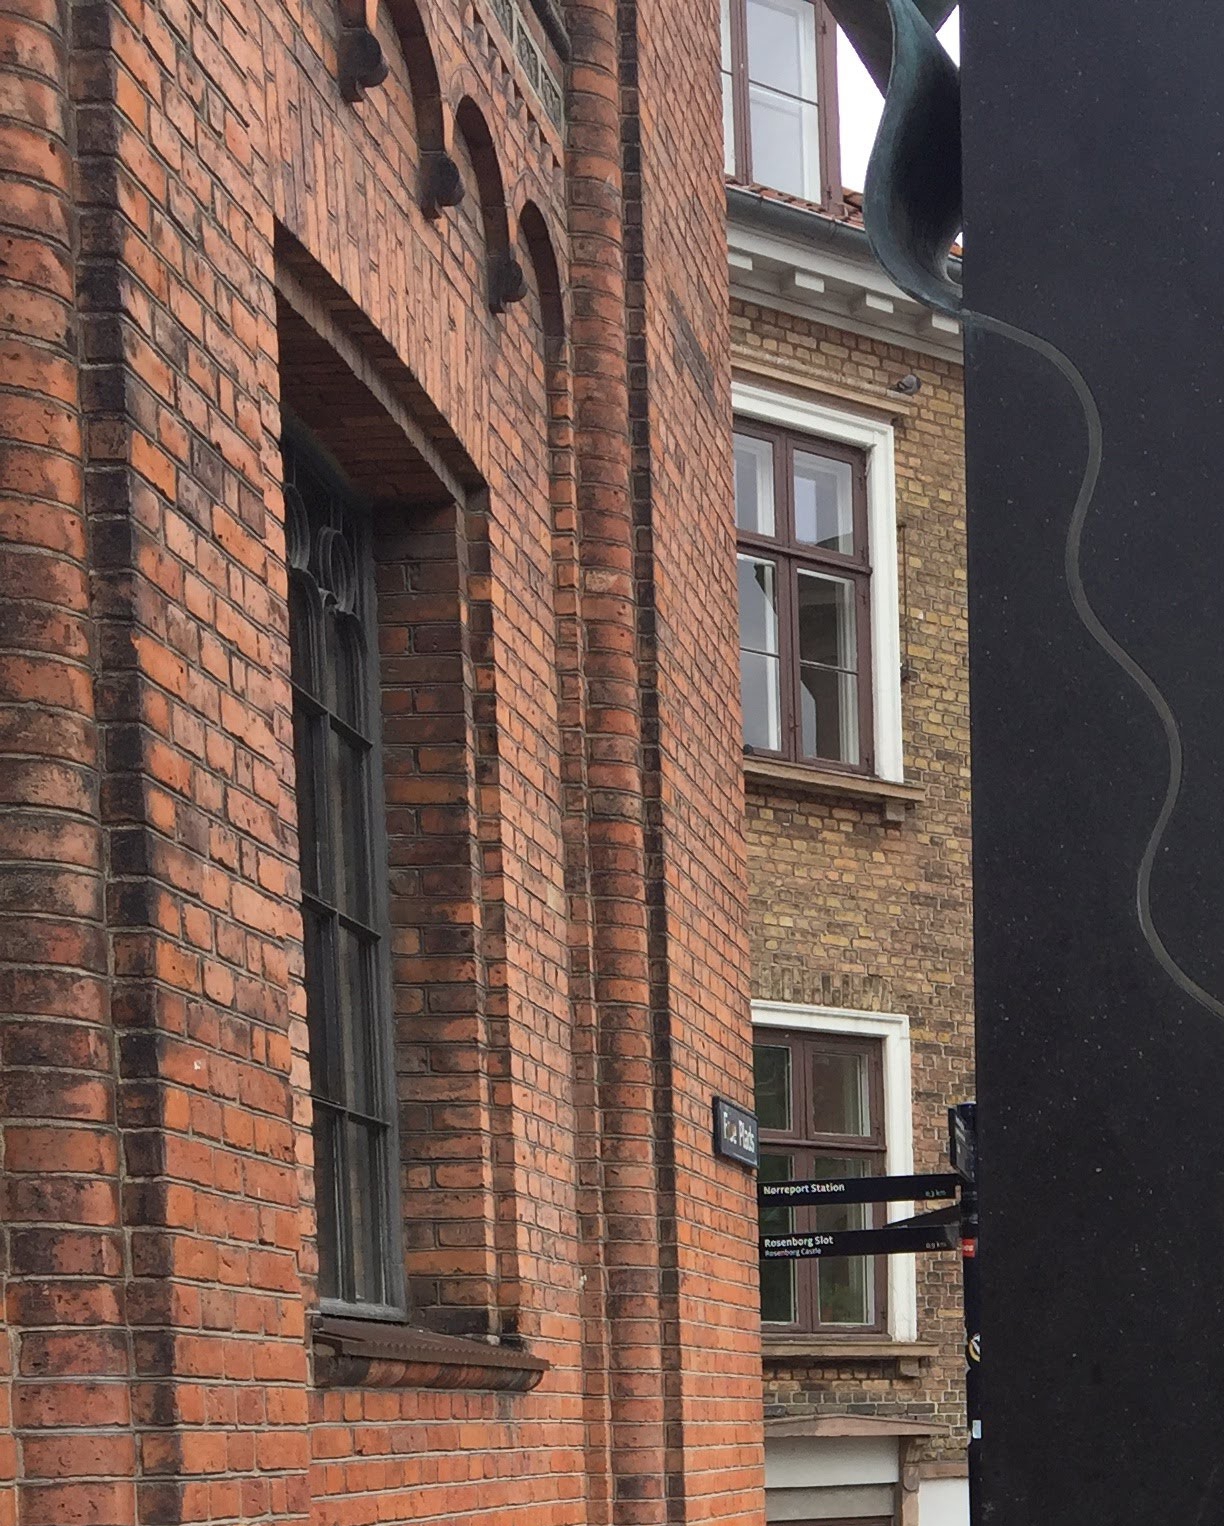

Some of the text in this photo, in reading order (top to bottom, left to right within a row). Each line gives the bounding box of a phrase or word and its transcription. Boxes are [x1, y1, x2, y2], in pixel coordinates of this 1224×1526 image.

[763, 1182, 845, 1196] Nørreport Station
[764, 1235, 834, 1247] Rosenborg Slot
[764, 1247, 821, 1257] Rosenborg Castle
